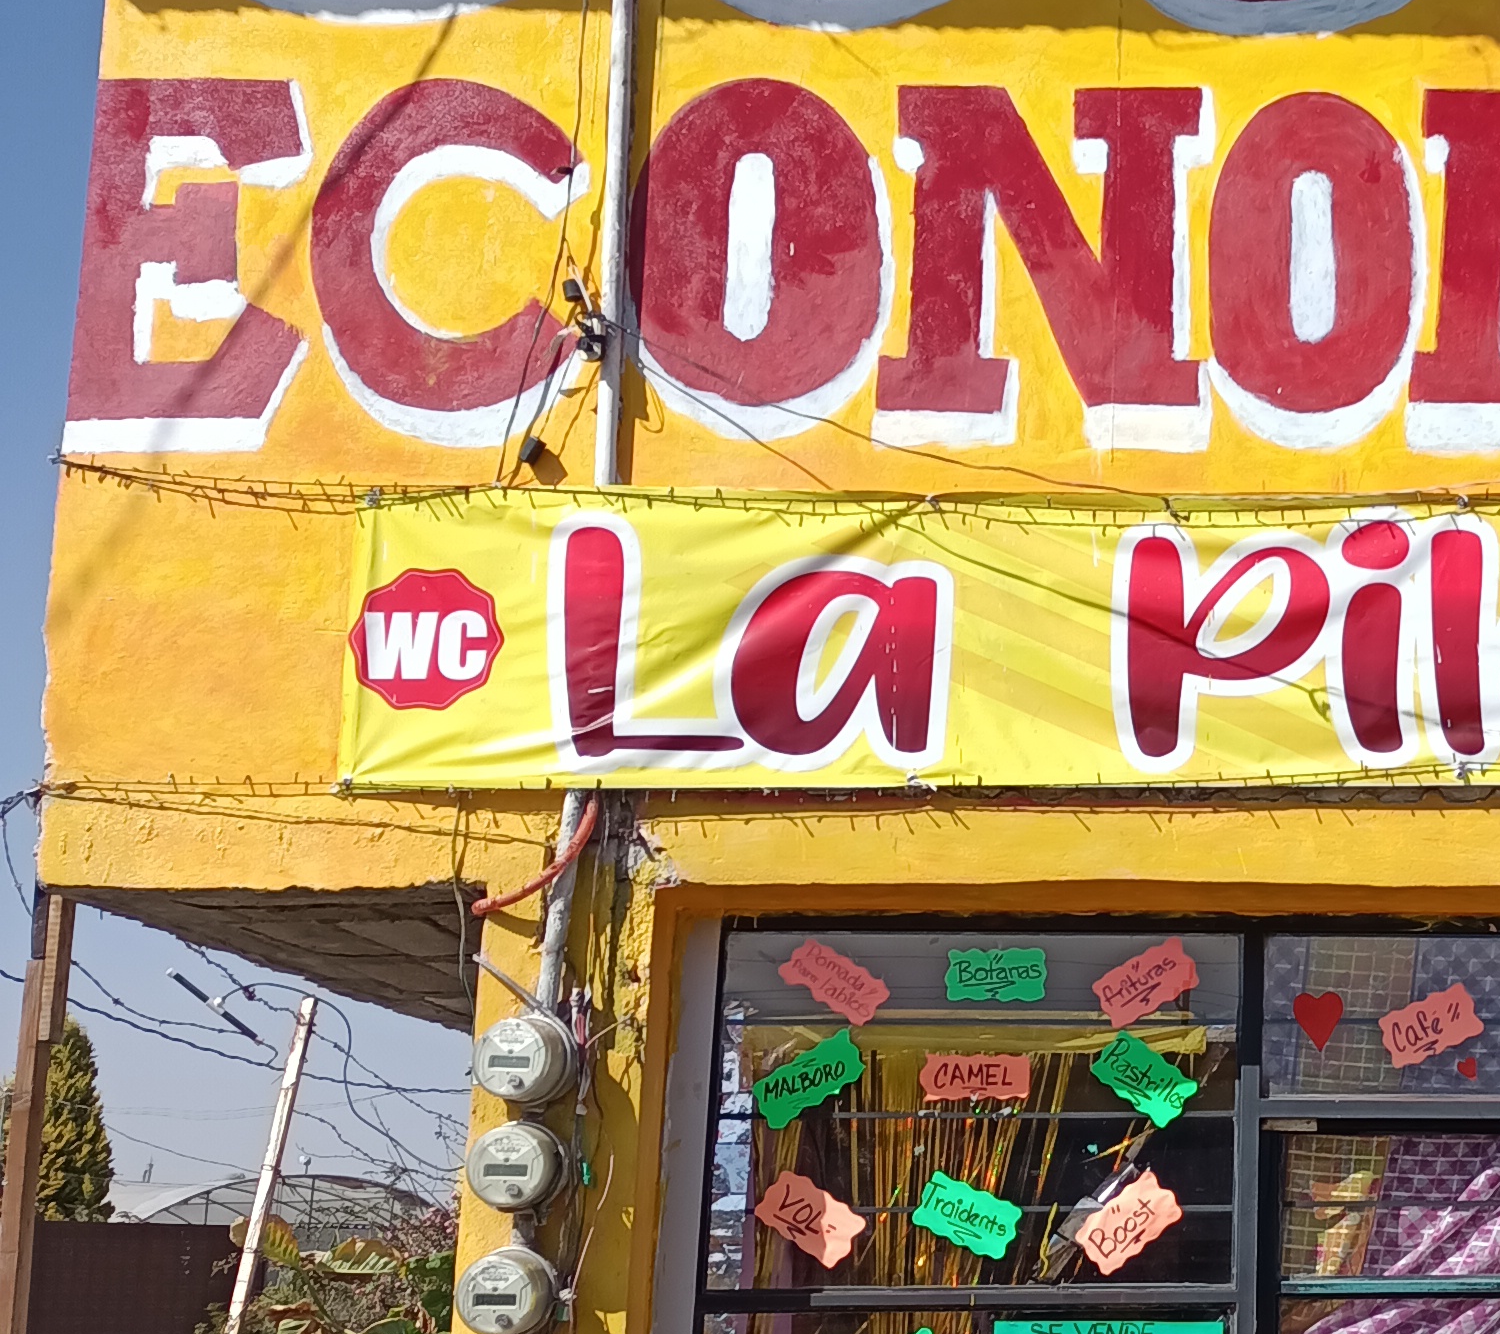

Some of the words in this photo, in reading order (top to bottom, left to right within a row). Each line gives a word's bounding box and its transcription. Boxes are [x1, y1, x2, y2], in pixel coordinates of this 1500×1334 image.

[363, 609, 490, 683] WC
[552, 509, 952, 771] La
[953, 960, 1042, 983] Botanas
[1392, 1010, 1443, 1052] Café
[764, 1060, 845, 1102] MALBORO
[933, 1063, 1013, 1089] CAMEL
[1103, 1038, 1184, 1109] Rastrillos
[1089, 1198, 1155, 1259] Boost
